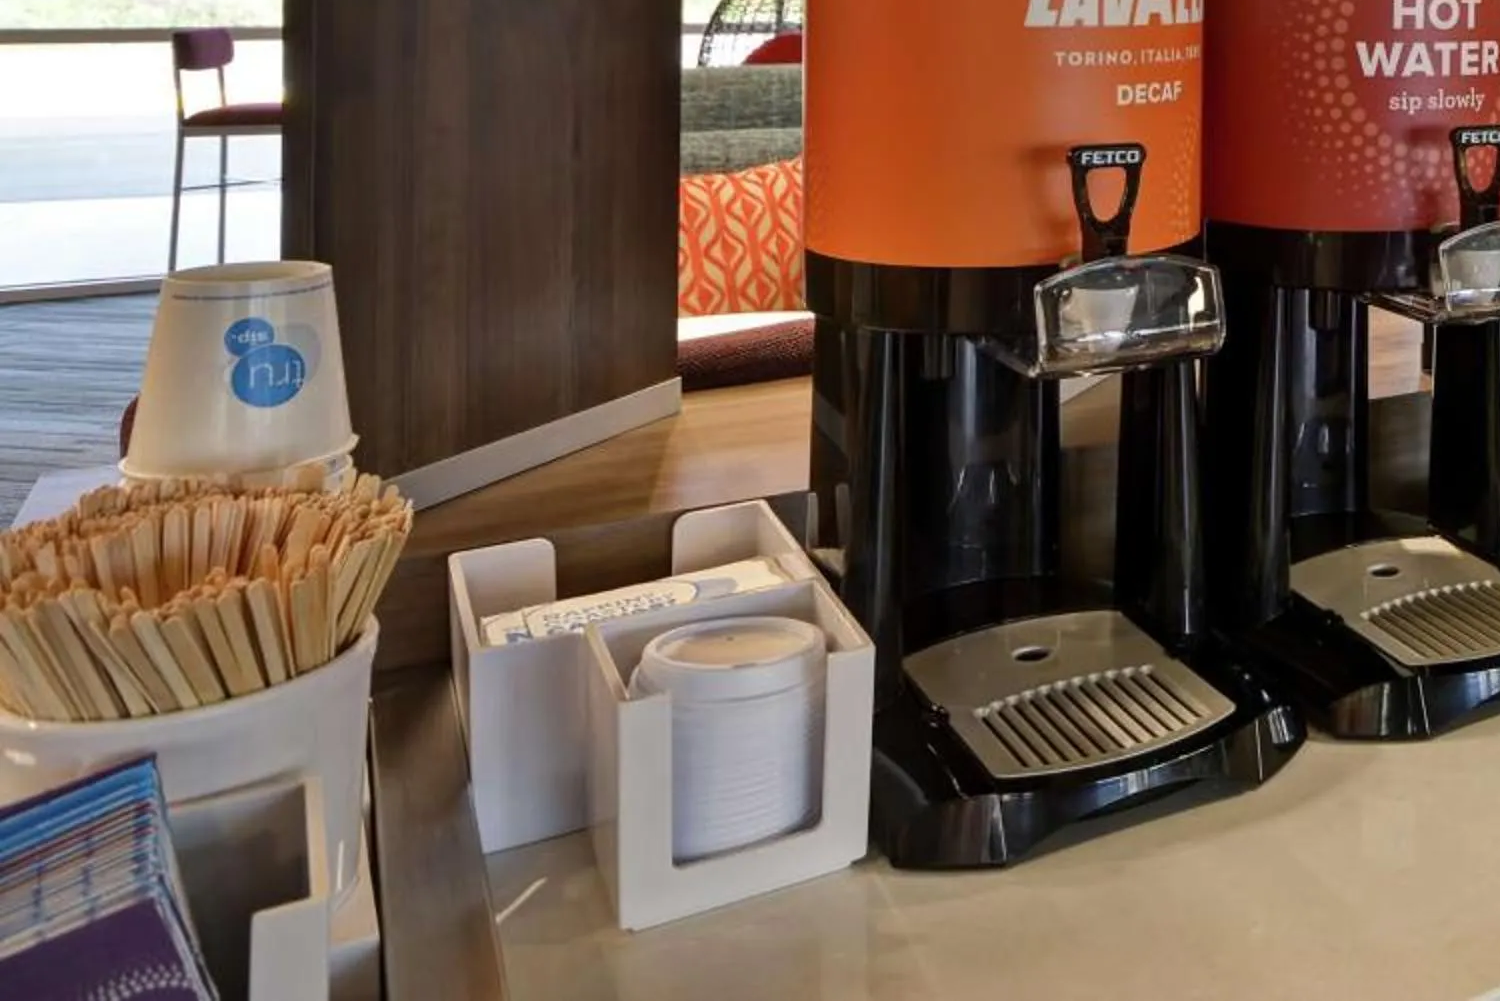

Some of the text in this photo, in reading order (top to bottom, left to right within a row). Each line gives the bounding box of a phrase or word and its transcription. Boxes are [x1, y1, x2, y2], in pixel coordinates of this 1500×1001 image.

[1355, 40, 1500, 77] WATER
[1116, 81, 1182, 106] DECAF
[1388, 87, 1486, 115] sip slowly
[1081, 150, 1140, 165] FETCO
[249, 359, 301, 390] tru
